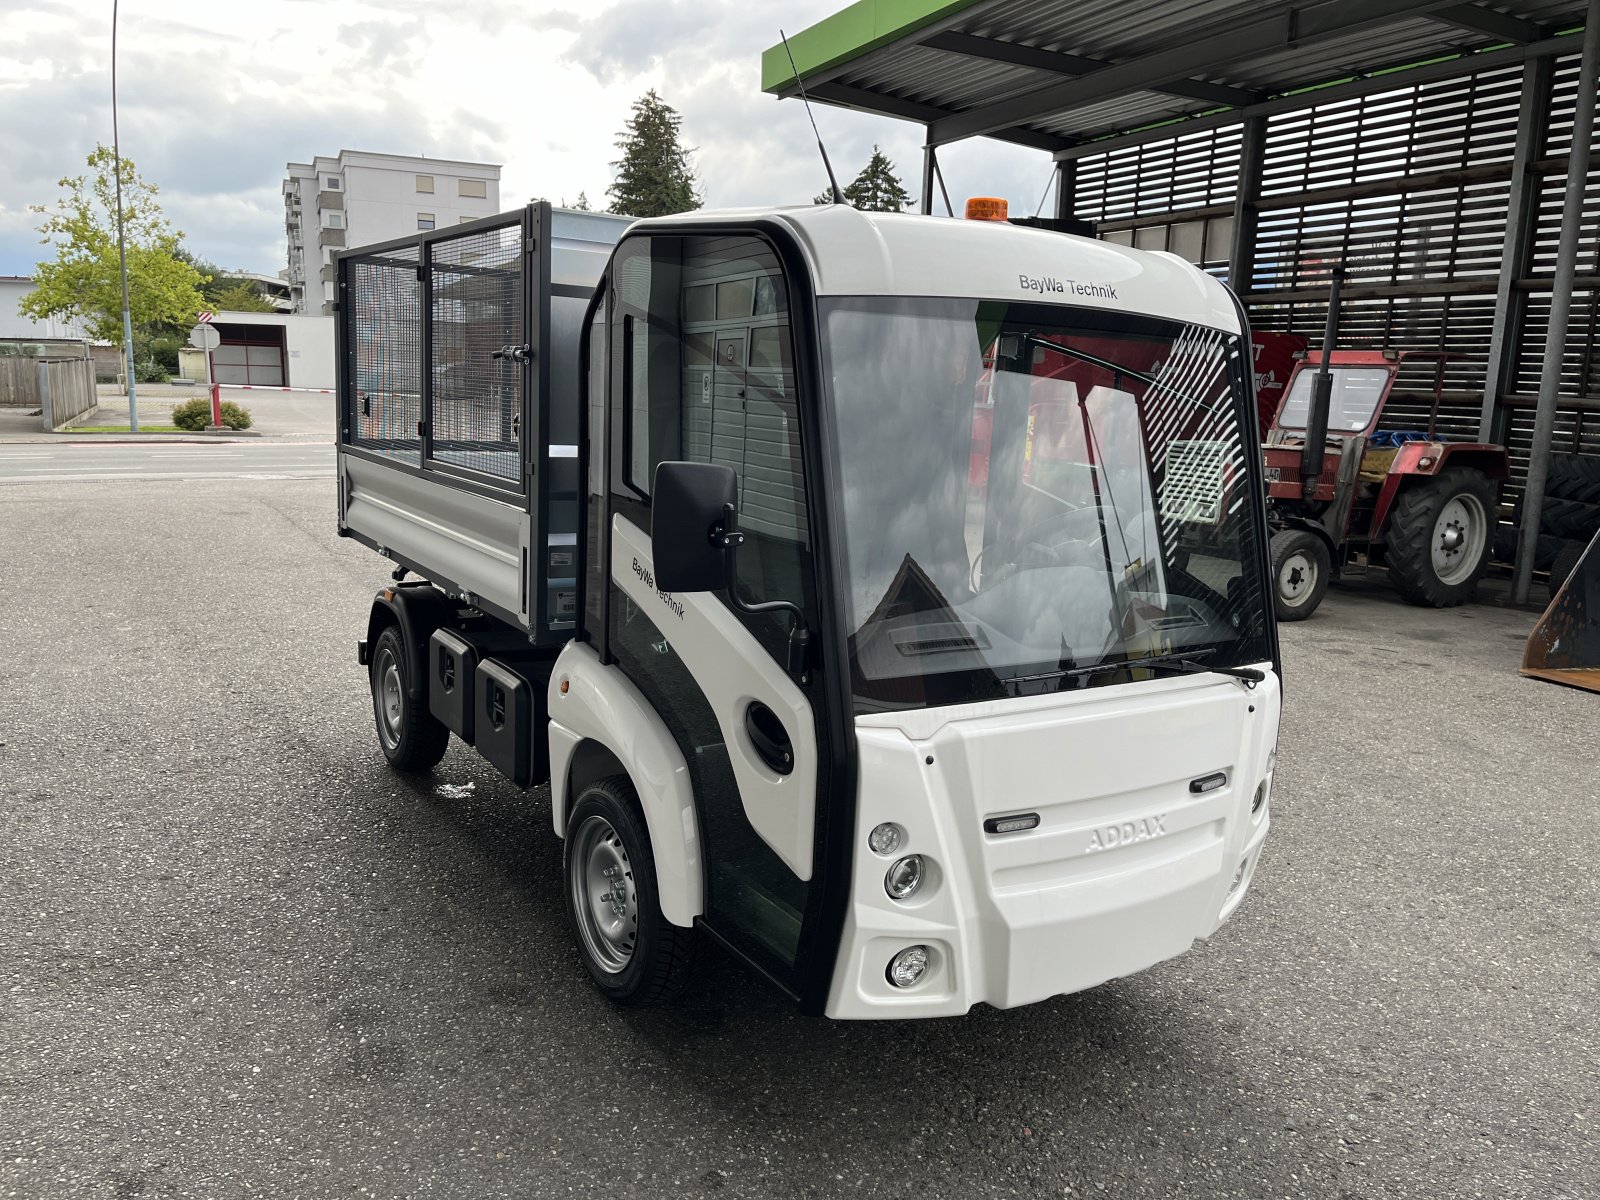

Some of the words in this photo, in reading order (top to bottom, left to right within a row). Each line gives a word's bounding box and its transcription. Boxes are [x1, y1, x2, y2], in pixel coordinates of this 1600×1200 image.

[1019, 274, 1064, 294] BayWa
[1066, 279, 1118, 300] Technik
[632, 556, 654, 589] BayWa
[1085, 813, 1167, 853] ADDAX
